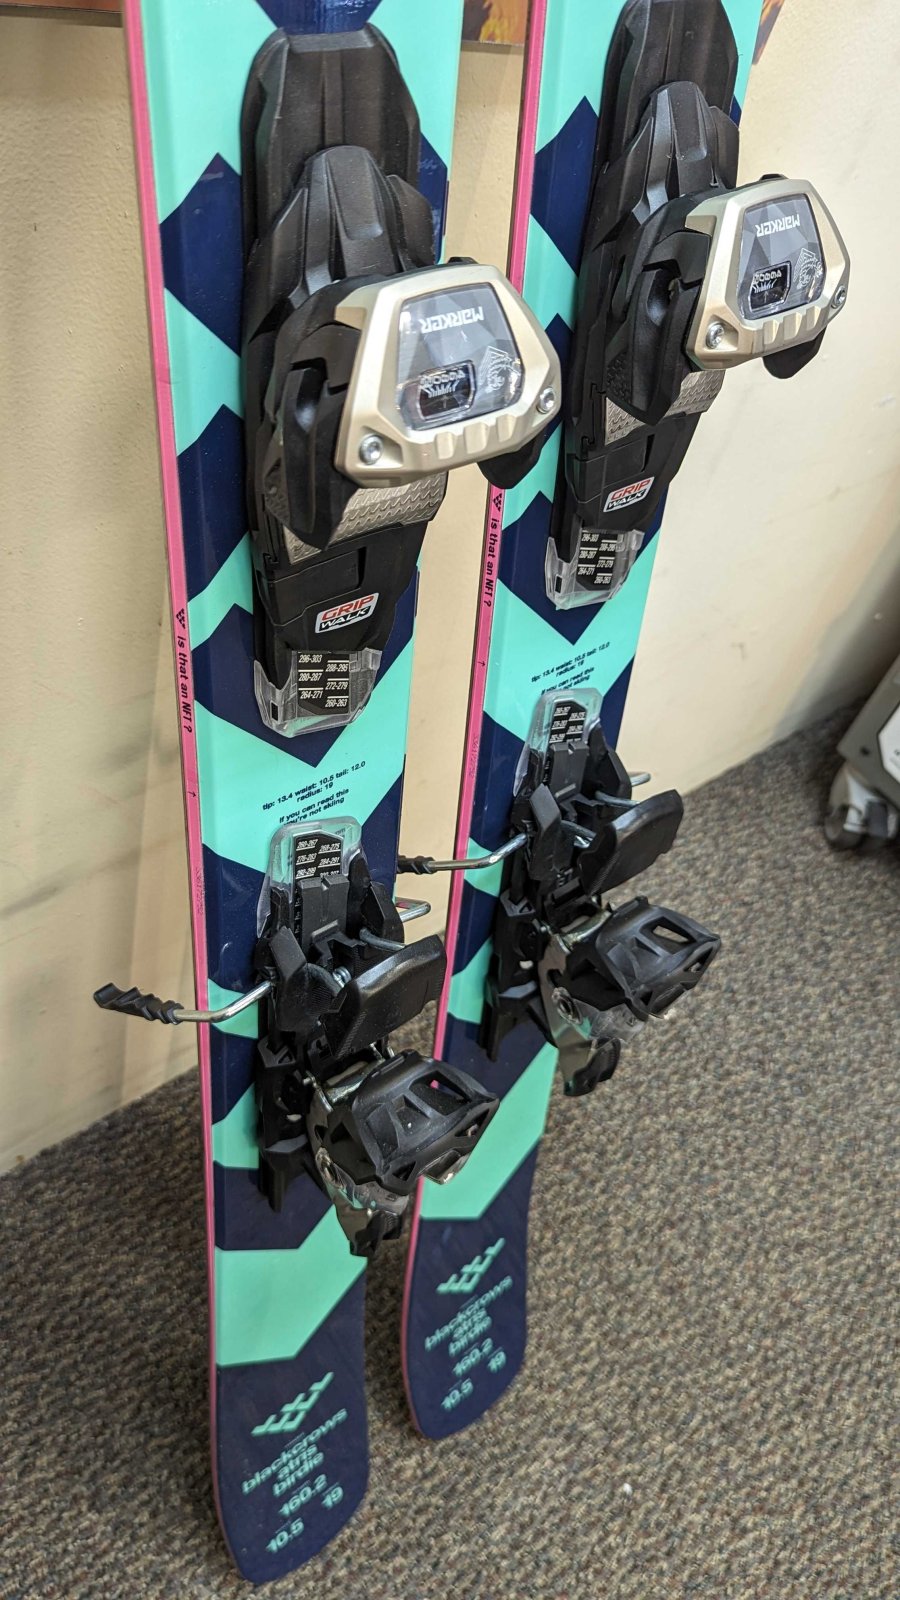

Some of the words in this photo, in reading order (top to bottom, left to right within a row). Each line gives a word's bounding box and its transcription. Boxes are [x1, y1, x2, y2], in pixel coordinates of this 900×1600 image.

[608, 491, 644, 508] WALK
[611, 479, 651, 500] GRIP
[490, 518, 499, 530] is
[488, 533, 499, 558] that
[485, 561, 493, 576] an
[484, 579, 493, 597] NFT
[320, 606, 368, 629] WALK
[321, 595, 375, 621] GRIP
[177, 635, 187, 648] is
[178, 652, 189, 680] that
[298, 654, 322, 663] 296-303
[298, 672, 323, 682] 280-287
[325, 681, 349, 690] 272-279
[180, 683, 189, 699] an
[300, 690, 324, 700] 264-271
[324, 698, 348, 708] 260-263
[181, 701, 192, 722] NFT
[262, 801, 276, 811] tip:
[277, 792, 294, 804] 13.4
[294, 782, 318, 797] waist:
[319, 774, 335, 786] 10.5
[335, 767, 350, 779] tail:
[351, 760, 366, 771] 12.0
[296, 787, 323, 803] radius:
[324, 781, 334, 791] 19
[285, 809, 301, 821] you
[301, 803, 316, 814] can
[317, 794, 335, 807] read
[335, 787, 350, 799] this
[308, 805, 322, 817] not
[323, 796, 345, 811] skiing
[424, 1275, 514, 1352] blackcrows
[452, 1307, 487, 1340] atris
[448, 1315, 493, 1358] birdie
[452, 1337, 494, 1378] 160.2
[487, 1350, 507, 1374] 19
[441, 1377, 474, 1413] 10.5
[241, 1407, 349, 1497] blackcrows
[276, 1443, 319, 1481] atris
[272, 1451, 325, 1499] birdie
[278, 1473, 328, 1518] 160.2
[321, 1486, 344, 1511] 19
[265, 1516, 305, 1554] 10.5
